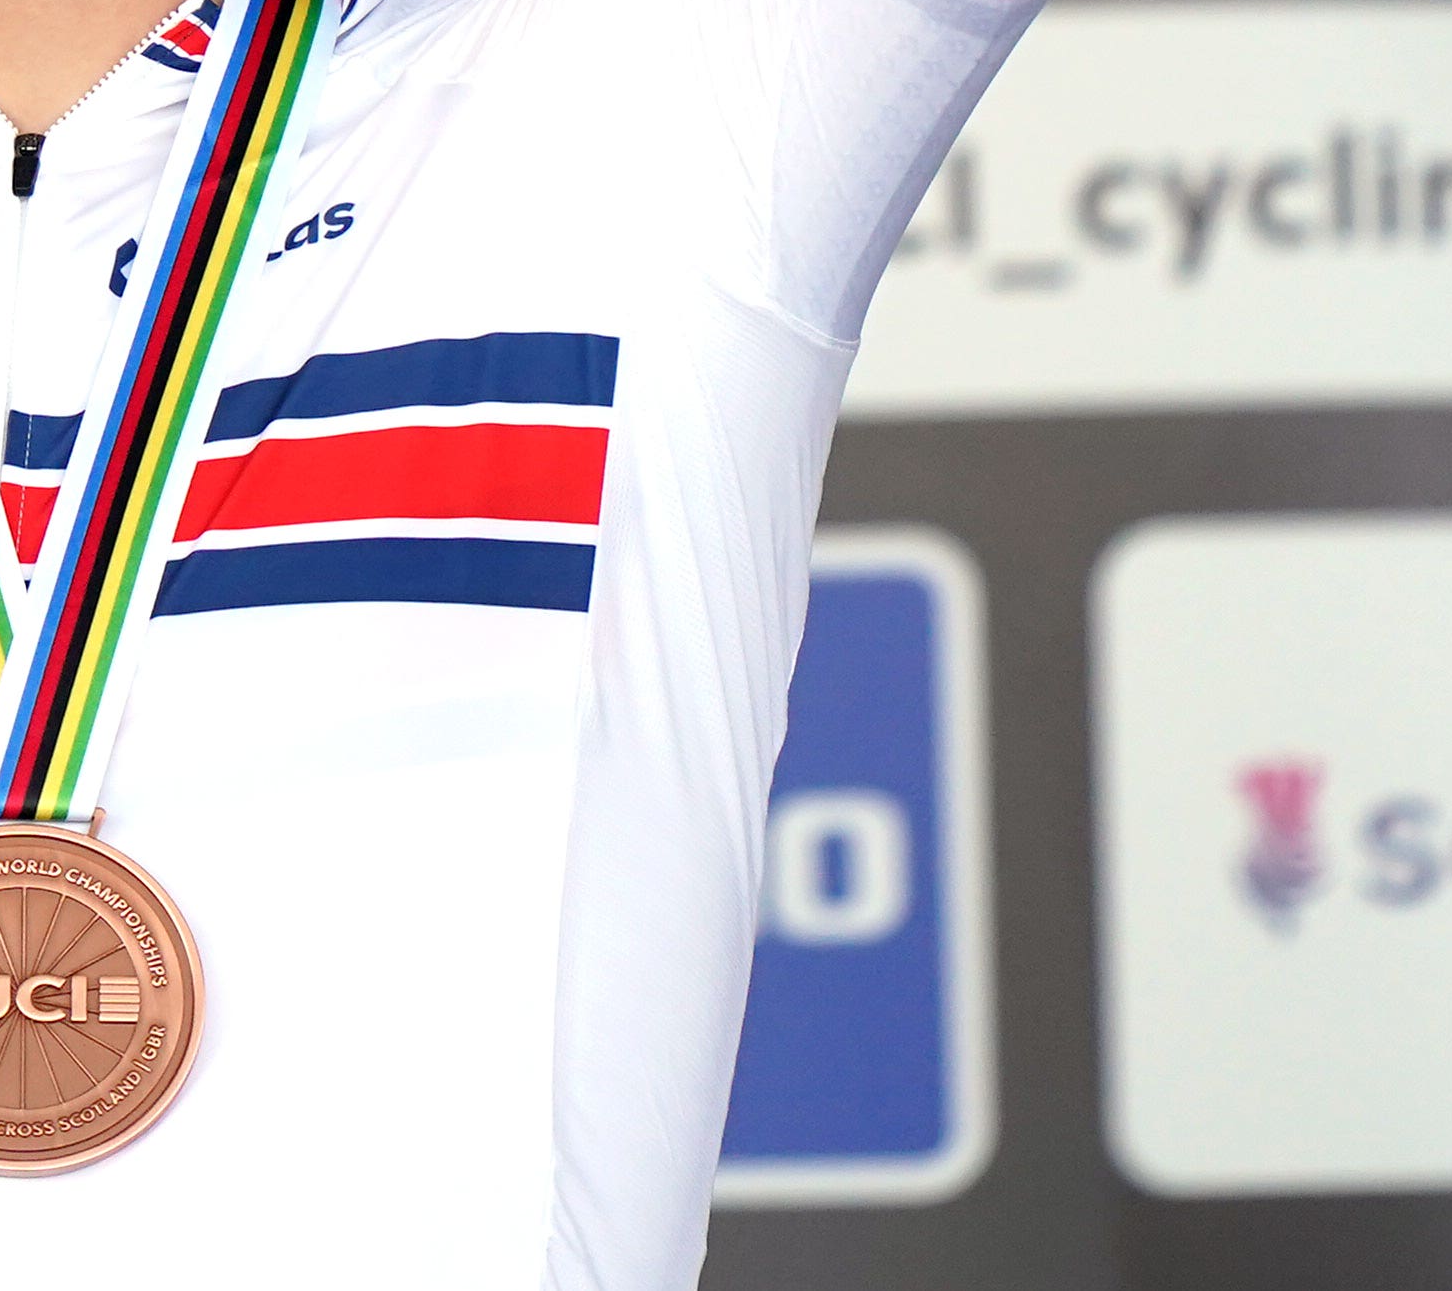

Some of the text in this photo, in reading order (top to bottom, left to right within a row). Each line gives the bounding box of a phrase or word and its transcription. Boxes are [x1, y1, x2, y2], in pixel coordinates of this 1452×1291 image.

[64, 867, 169, 989] CHAMPIONSHIPS
[58, 1069, 143, 1132] SCOTLAND
[142, 1023, 168, 1062] GBR
